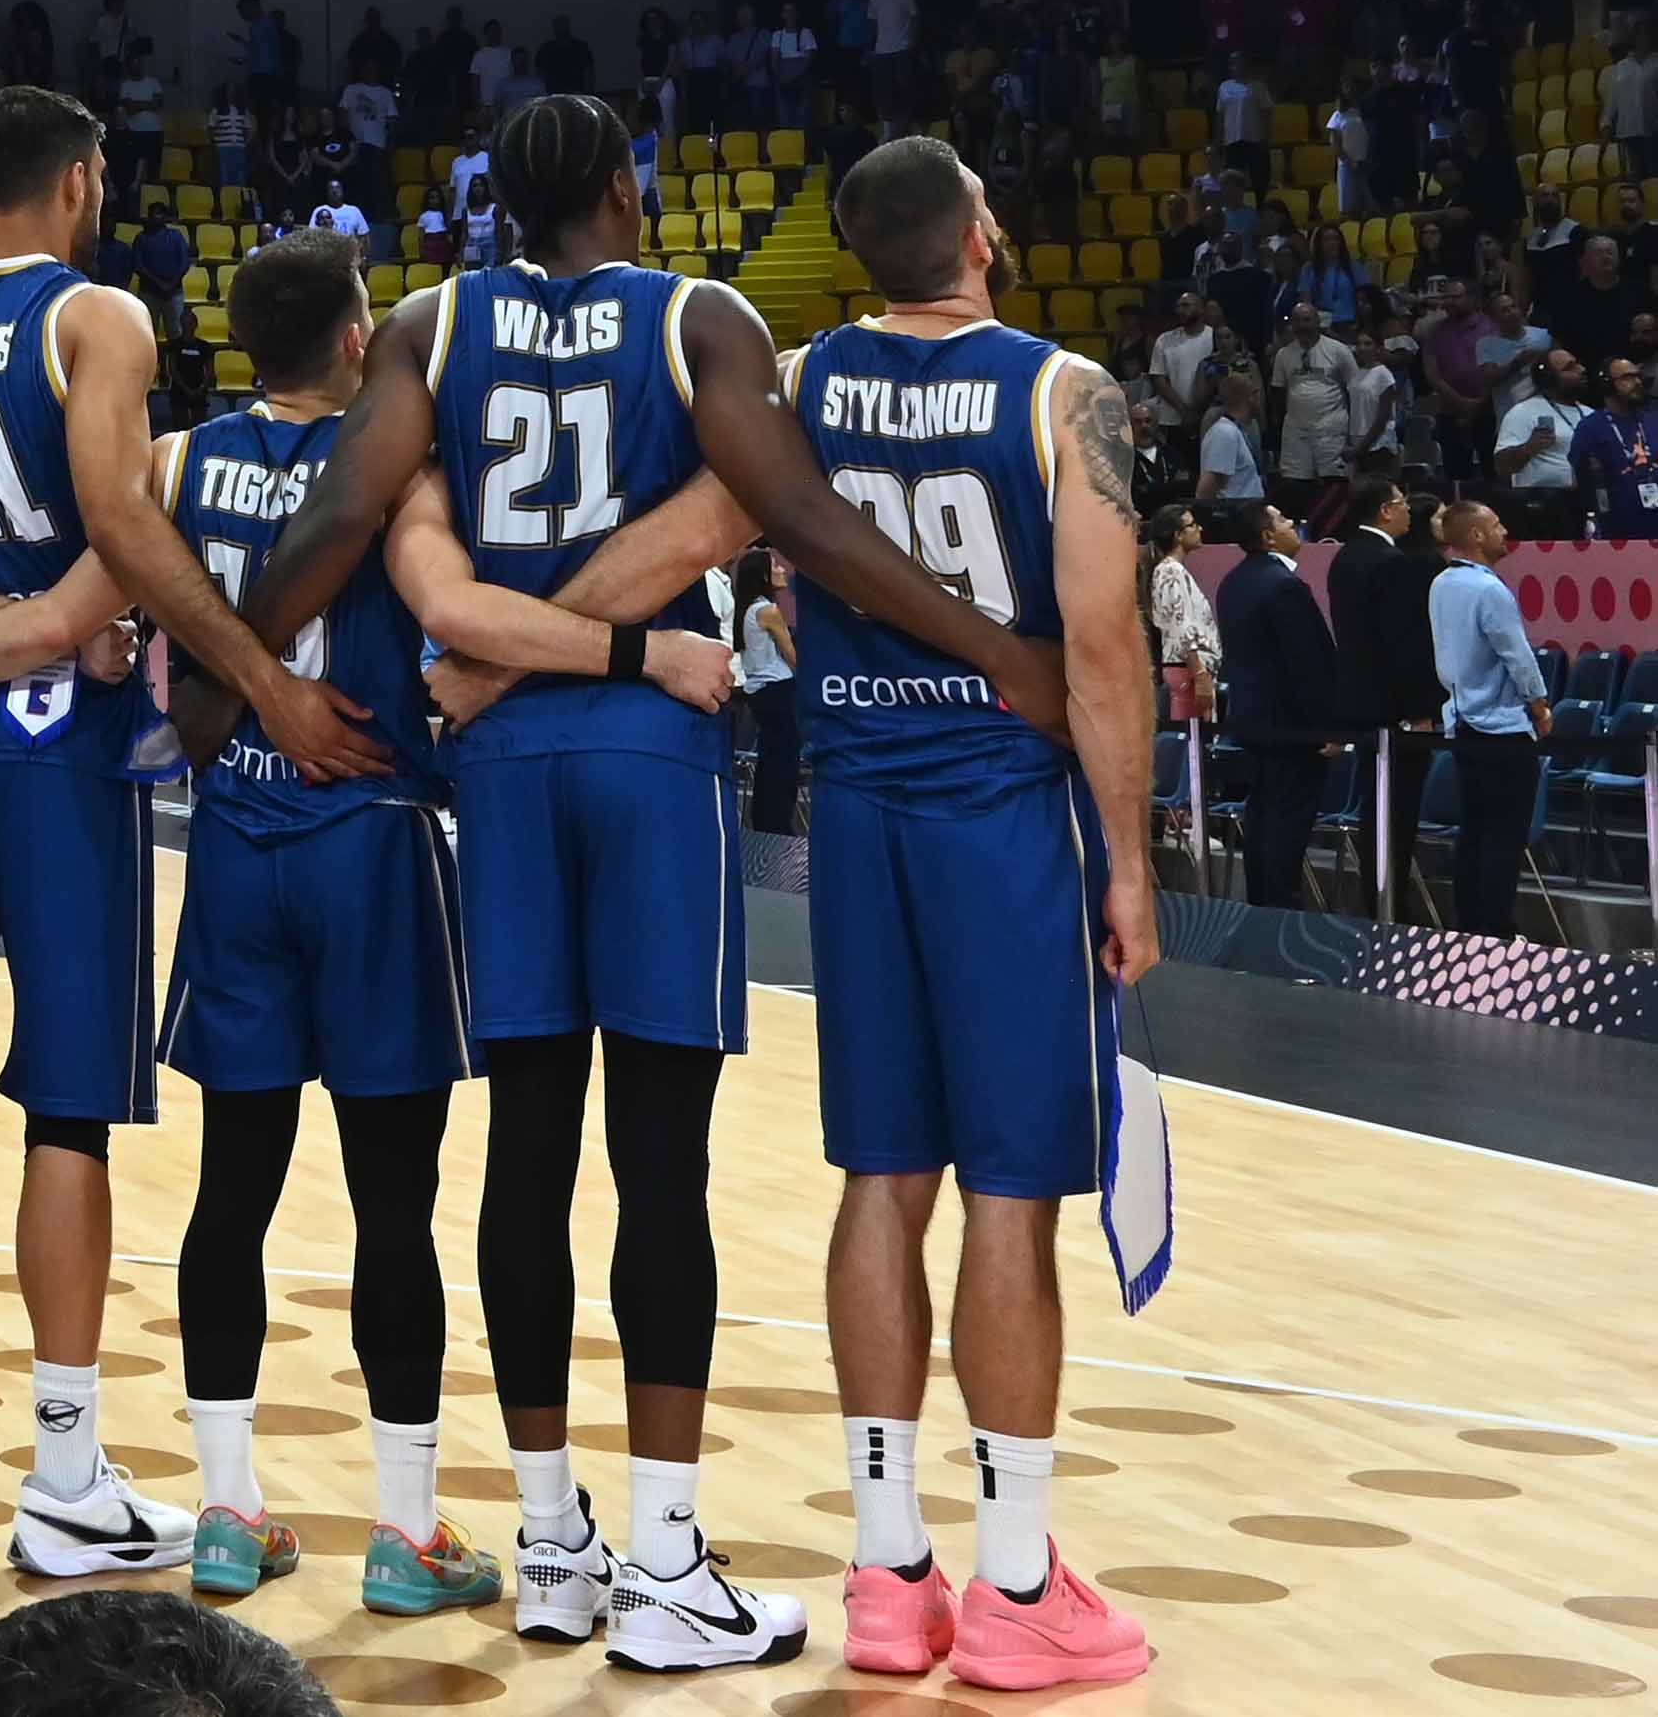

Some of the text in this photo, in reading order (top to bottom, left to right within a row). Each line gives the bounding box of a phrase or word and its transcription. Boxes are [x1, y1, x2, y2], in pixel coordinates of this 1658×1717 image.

[821, 371, 999, 441] STYLIANOU
[477, 381, 624, 549] 21
[532, 1545, 558, 1558] GIGI
